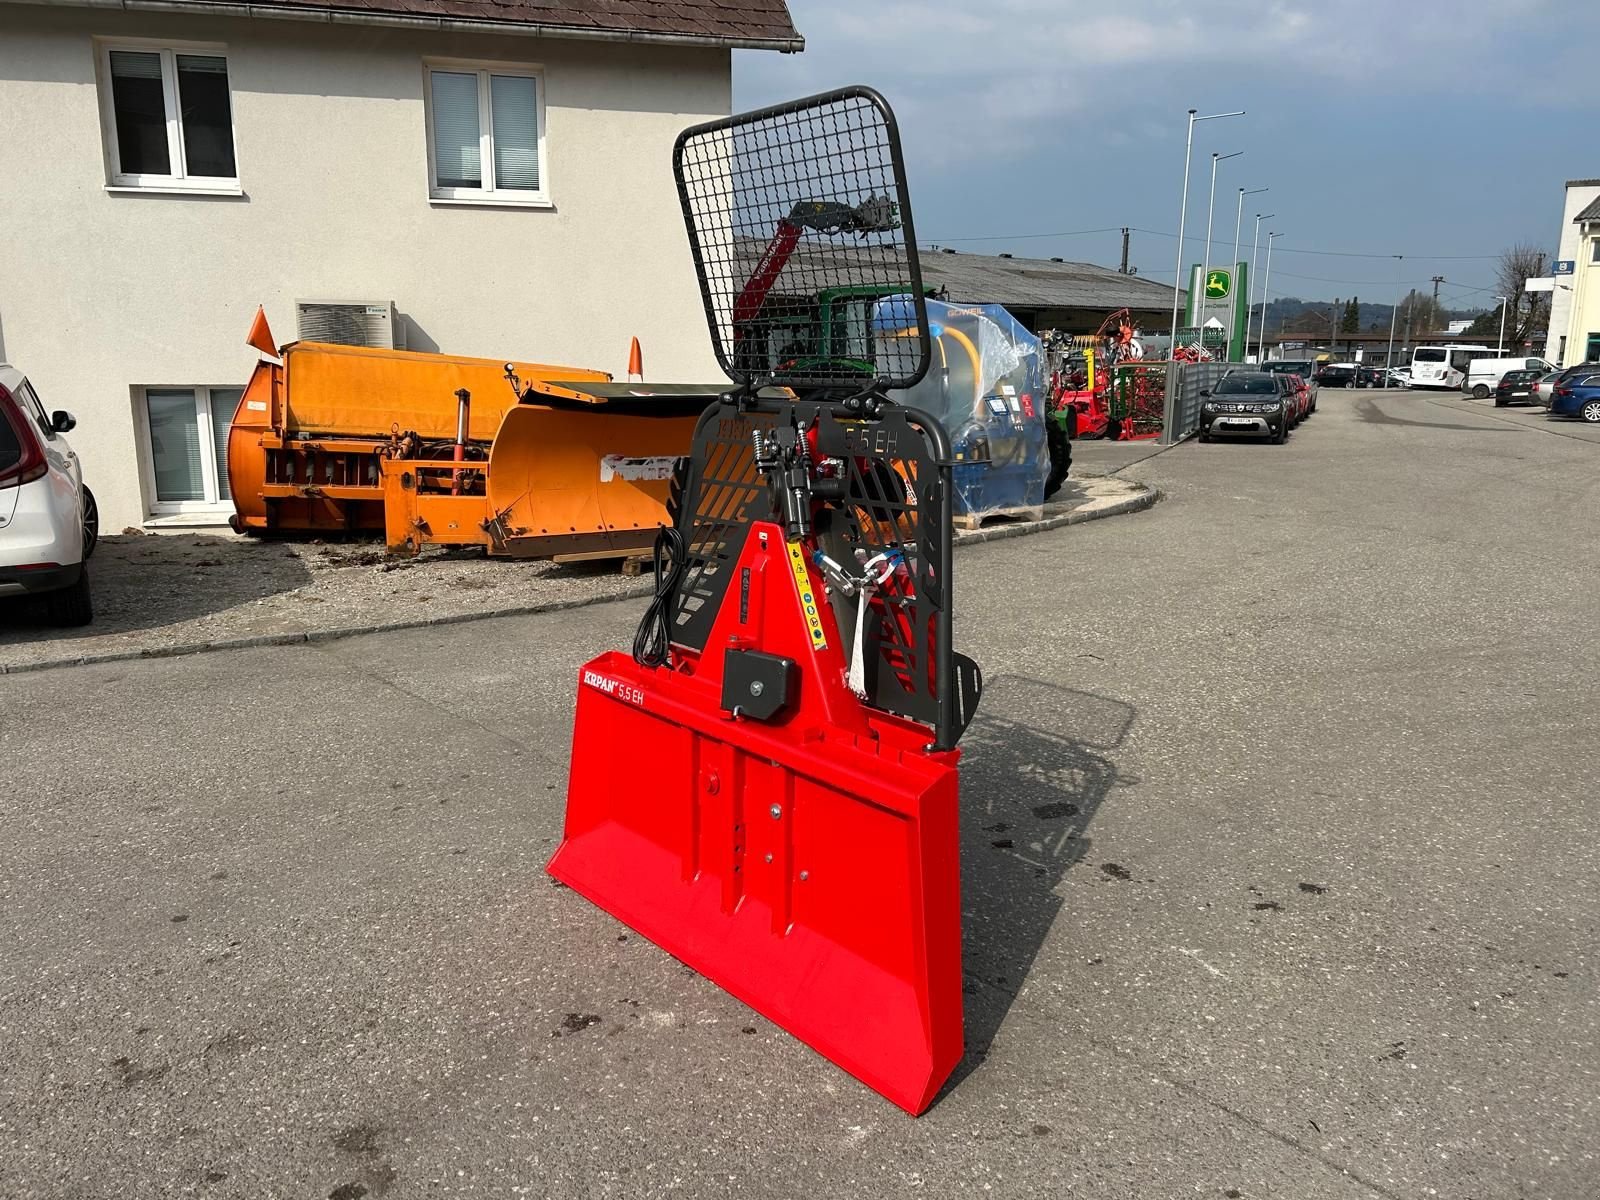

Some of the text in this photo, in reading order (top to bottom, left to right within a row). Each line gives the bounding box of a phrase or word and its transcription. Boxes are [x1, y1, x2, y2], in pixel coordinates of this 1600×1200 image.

[875, 430, 898, 453] EH
[618, 684, 631, 700] 5,5
[632, 689, 644, 705] EH
